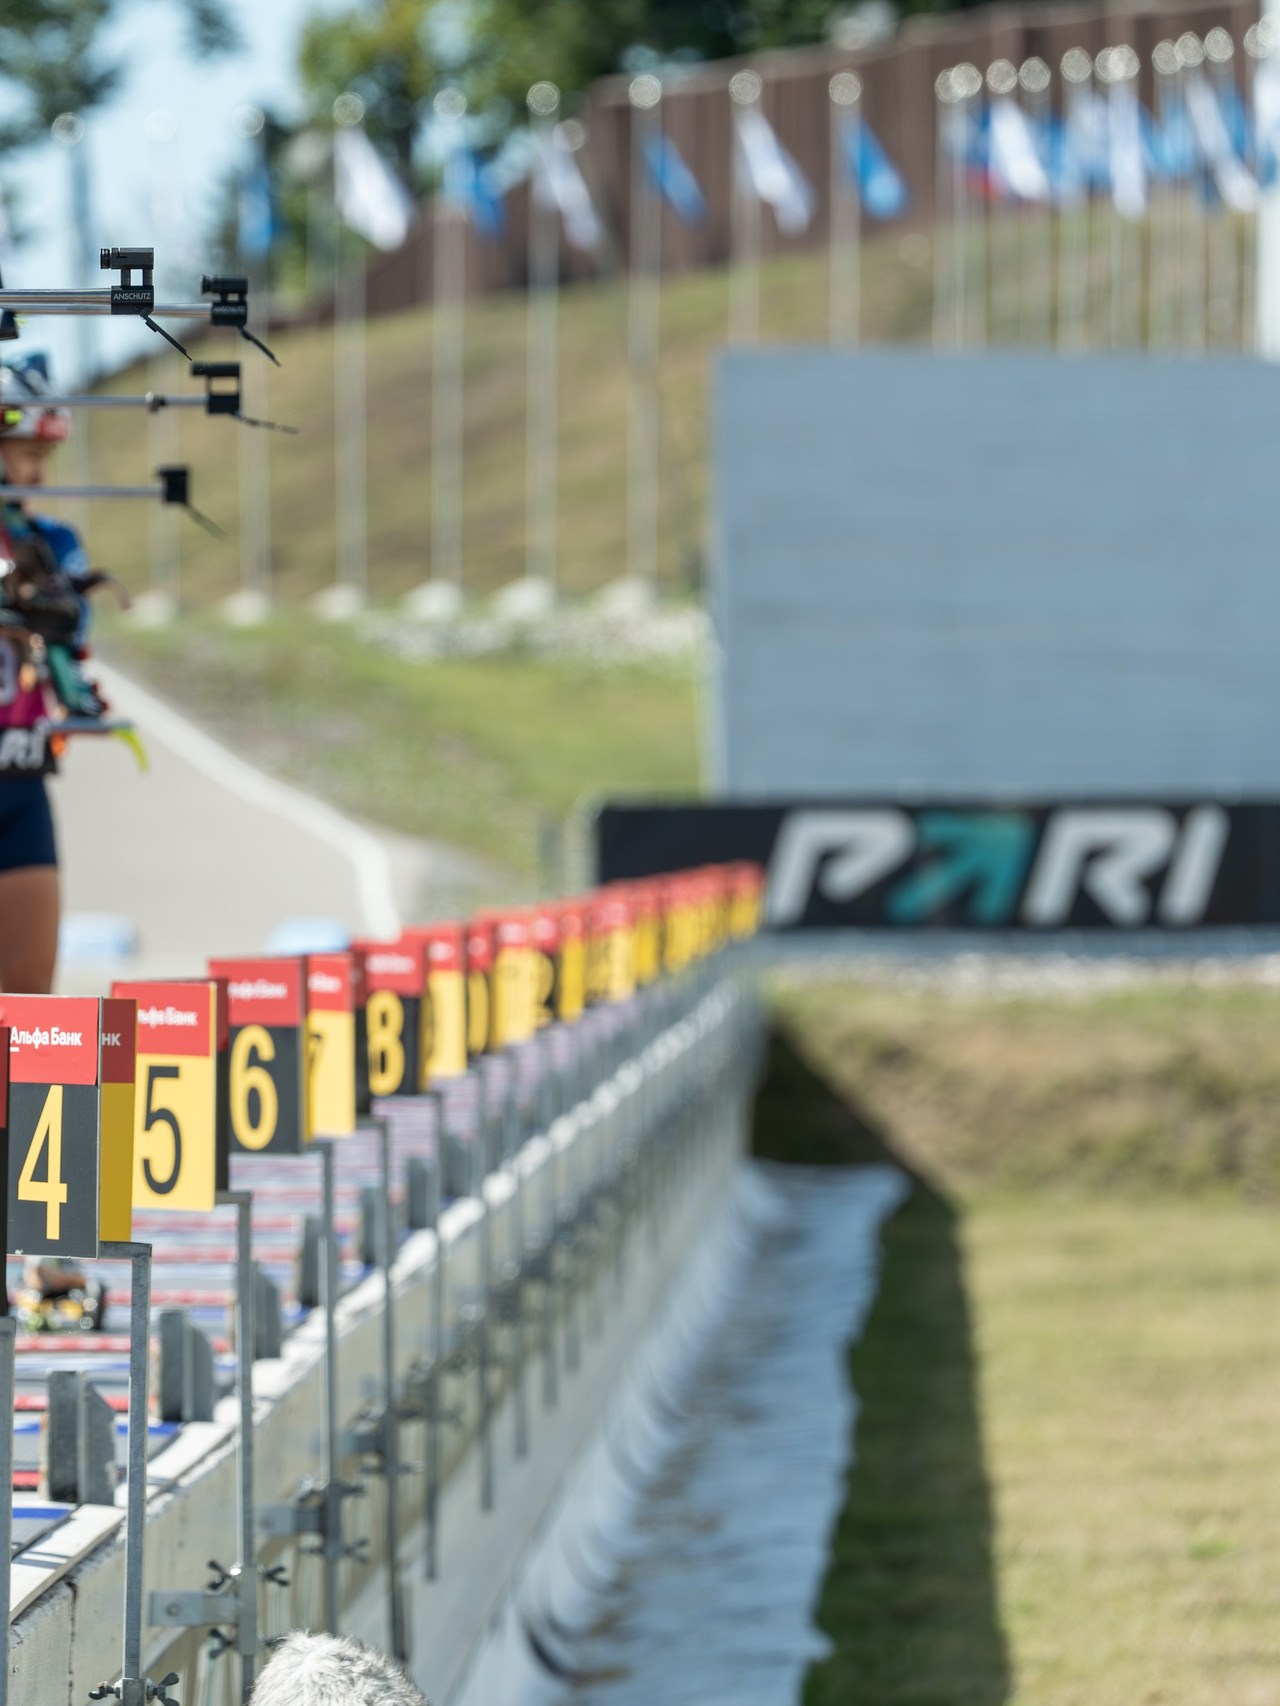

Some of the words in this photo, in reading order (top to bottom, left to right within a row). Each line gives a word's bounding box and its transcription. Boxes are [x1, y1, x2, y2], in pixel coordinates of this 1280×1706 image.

[763, 804, 1230, 928] PARI
[10, 1026, 49, 1053] Альфа
[51, 1027, 82, 1046] Банк
[229, 1024, 278, 1151] 6
[366, 989, 405, 1096] 8
[18, 1084, 67, 1240] 4
[142, 1065, 184, 1196] 5
